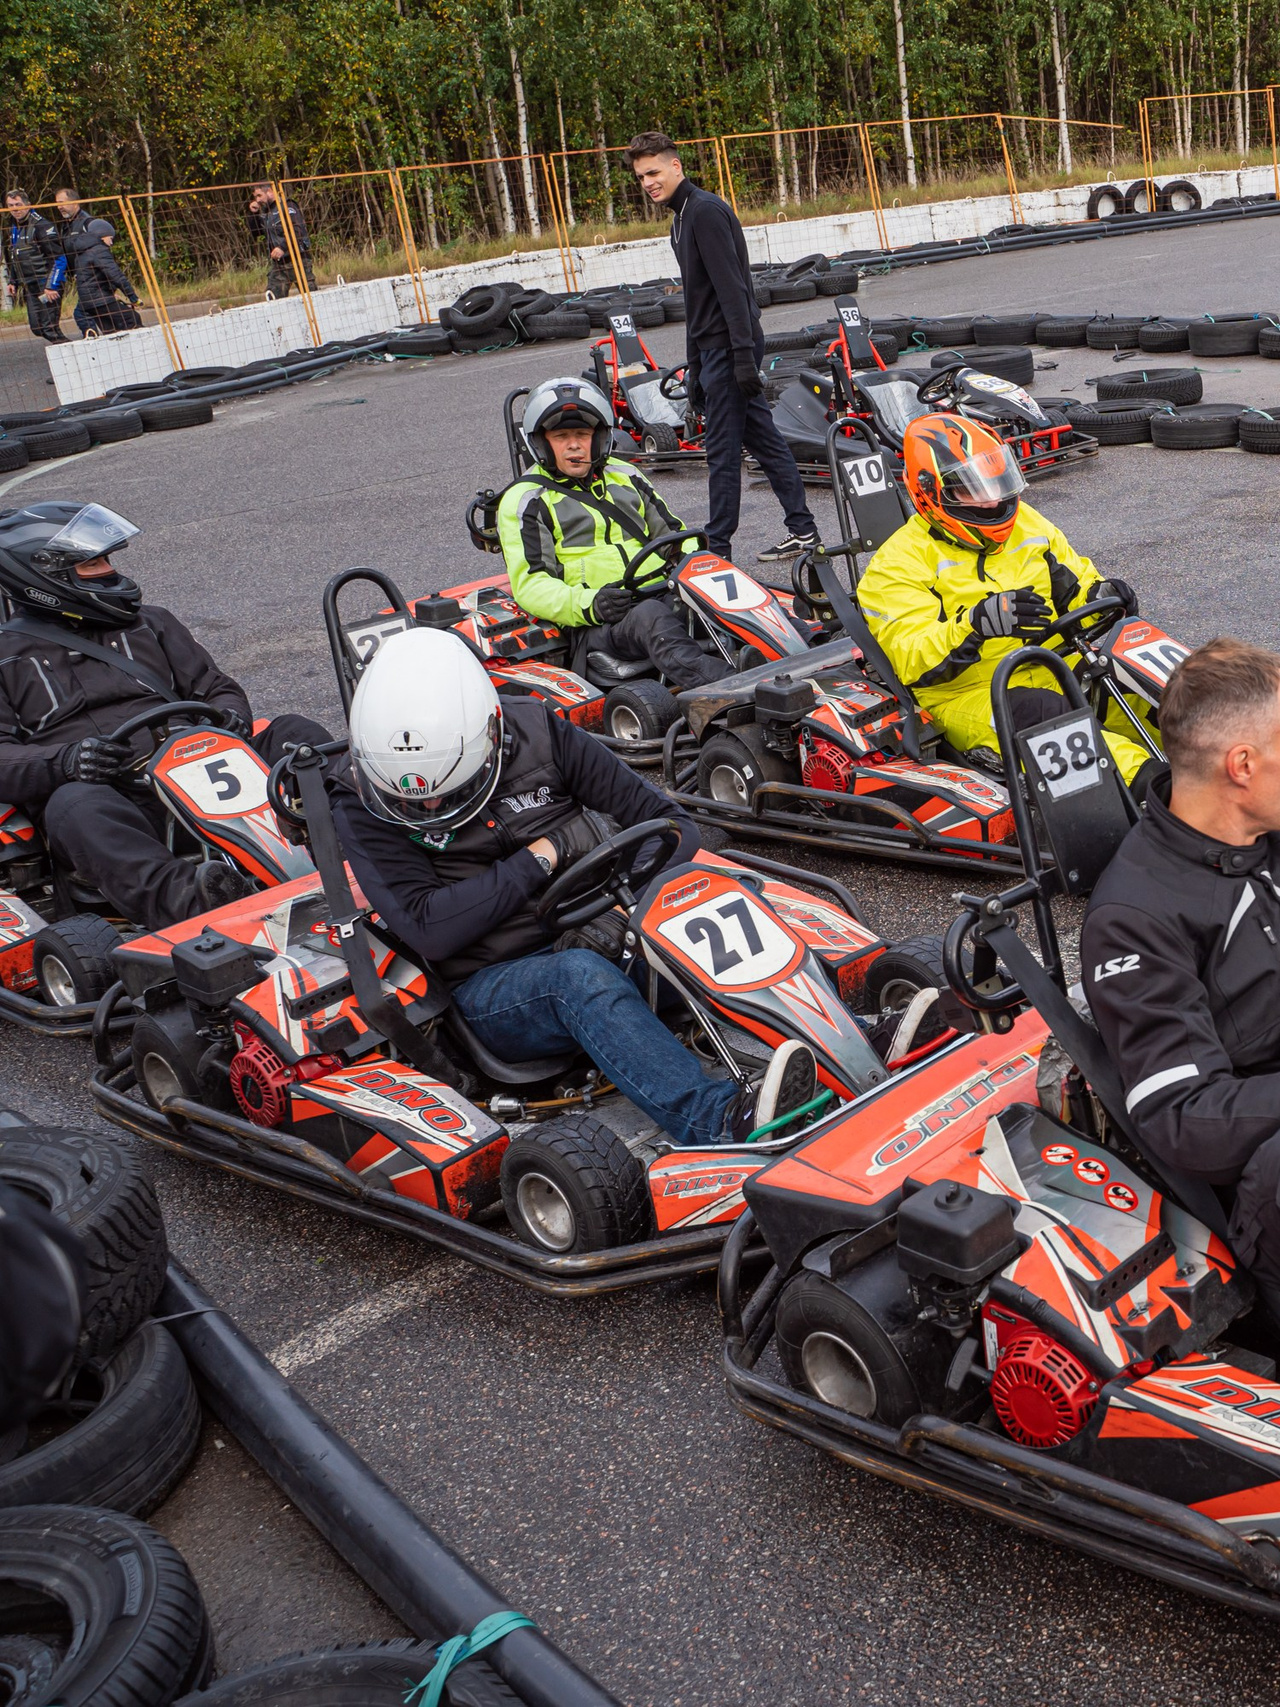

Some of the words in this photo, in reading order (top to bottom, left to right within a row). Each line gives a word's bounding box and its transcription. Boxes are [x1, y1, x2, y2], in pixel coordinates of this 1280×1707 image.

[613, 317, 630, 329] 34
[842, 310, 859, 322] 36
[849, 459, 883, 487] 10
[29, 589, 57, 606] SHOEI
[711, 573, 738, 602] 7
[175, 738, 217, 757] DINO
[1038, 731, 1096, 781] 38
[204, 758, 241, 801] 5
[662, 879, 709, 907] DINO
[684, 898, 764, 976] 27
[1094, 954, 1141, 982] LS2
[344, 1070, 467, 1133] DINO
[875, 1053, 1036, 1167] DINO
[663, 1173, 742, 1195] DINO
